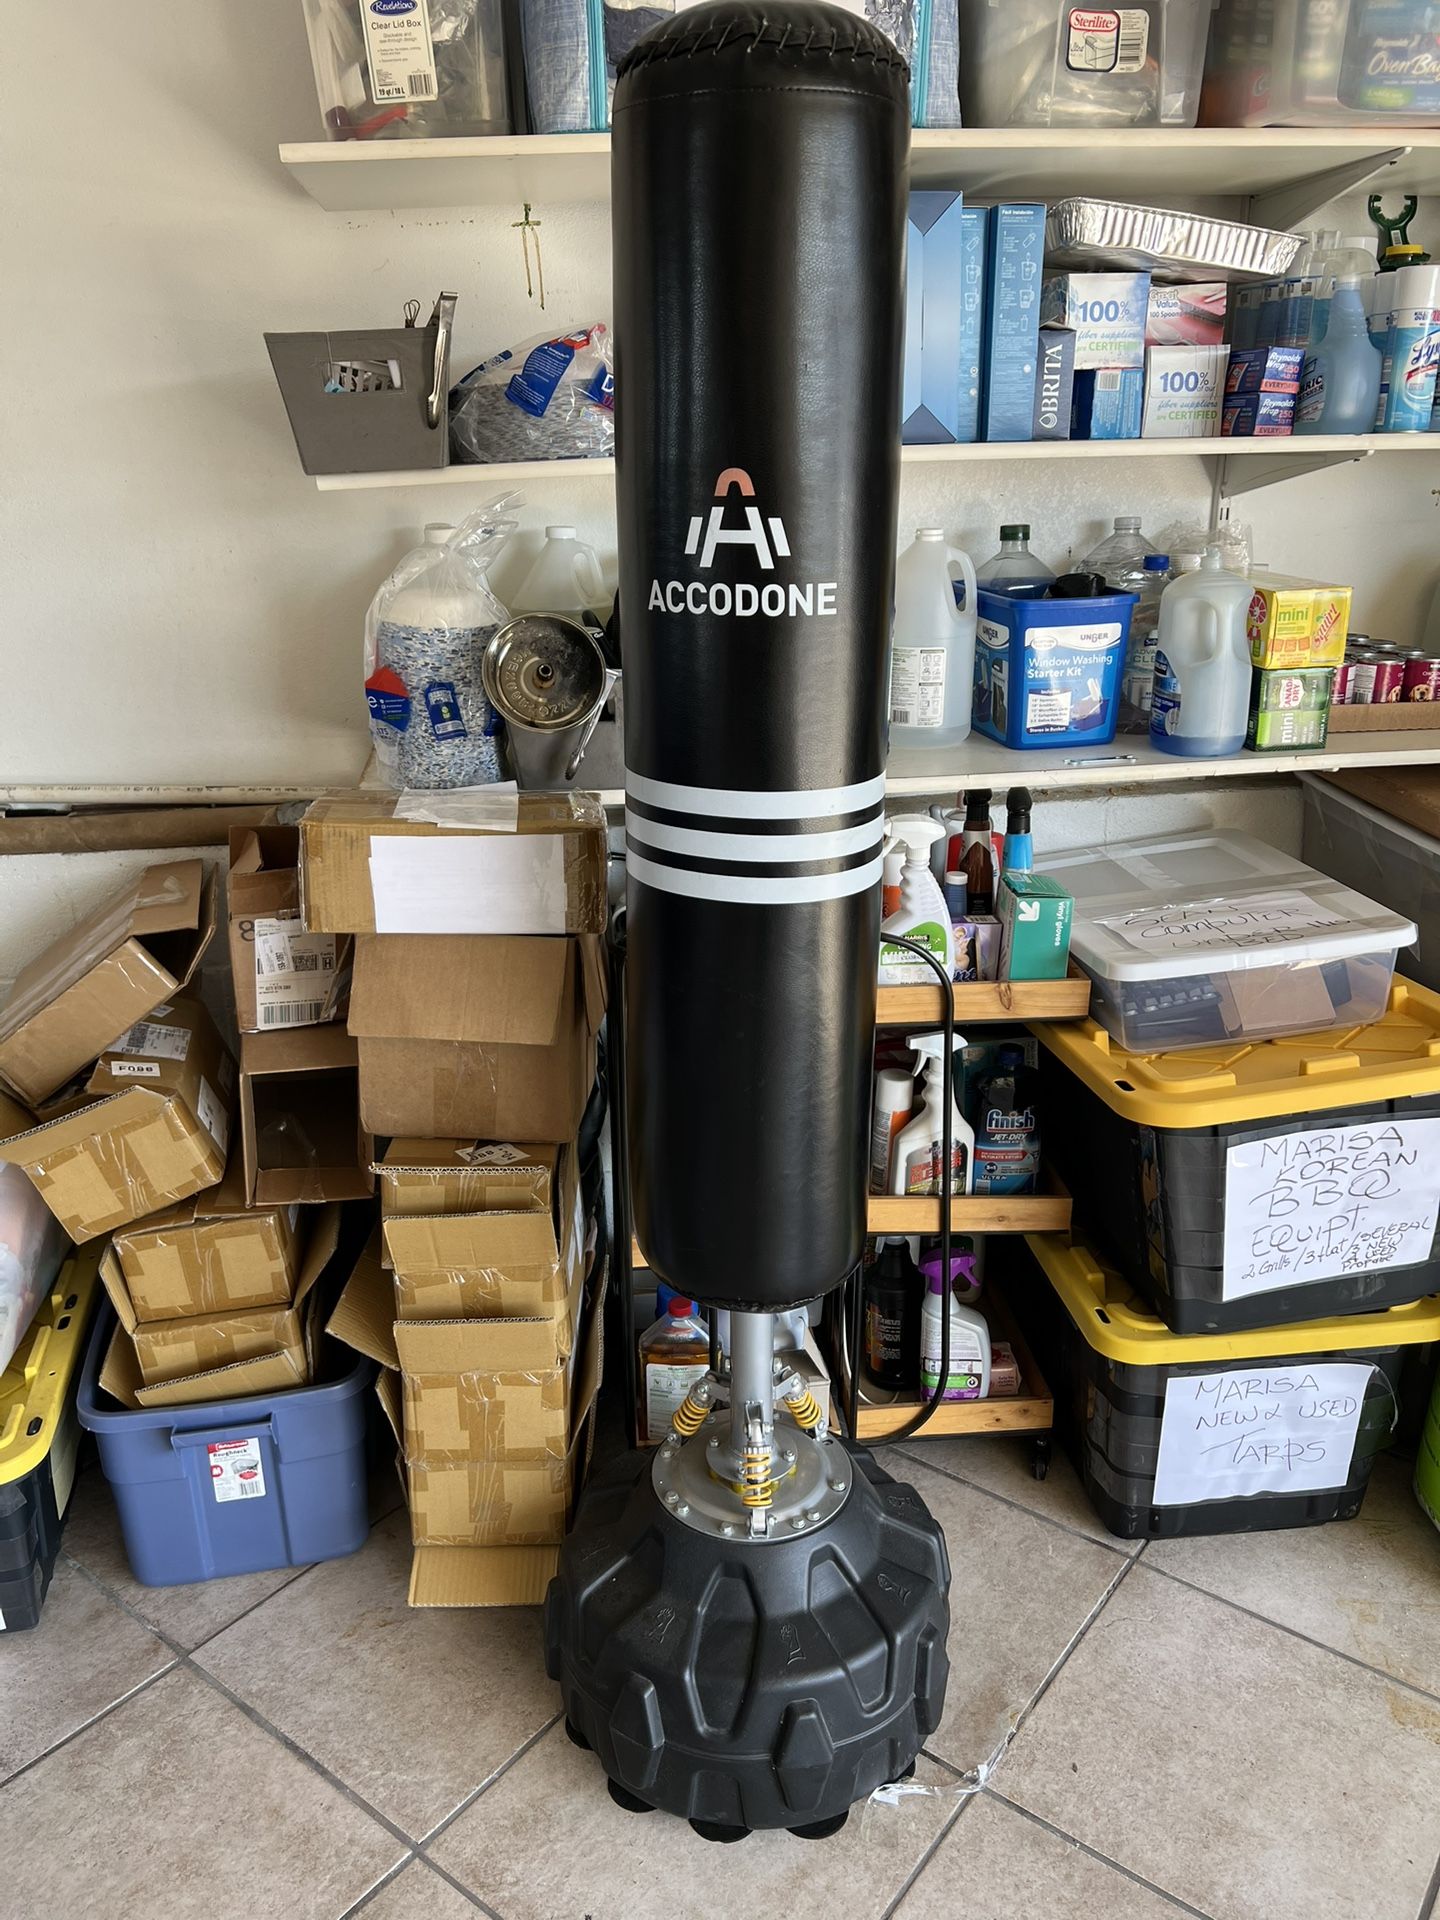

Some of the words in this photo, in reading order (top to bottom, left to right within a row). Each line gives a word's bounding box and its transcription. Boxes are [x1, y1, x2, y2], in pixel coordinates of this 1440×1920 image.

[371, 22, 391, 30] Clear
[393, 21, 405, 29] Lid
[1074, 14, 1113, 28] Sterilite
[1368, 51, 1409, 75] Oven
[1149, 289, 1180, 300] Great
[1079, 300, 1130, 322] 100%
[1156, 300, 1179, 308] Value
[1266, 360, 1286, 370] Wrap
[1269, 352, 1302, 363] Reynolds
[1041, 344, 1063, 412] BRITA
[1160, 371, 1209, 392] 100%
[1157, 400, 1178, 411] fiber
[1180, 400, 1218, 411] suppliers
[1260, 406, 1280, 416] Wrap
[1263, 399, 1296, 409] Reynolds
[1168, 410, 1217, 420] CERTIFIED
[648, 579, 838, 617] ACCODONE
[1279, 608, 1309, 621] mini
[982, 625, 999, 640] UNGER
[1080, 632, 1109, 643] UNGER
[1029, 657, 1071, 668] Window
[1073, 655, 1113, 665] Washing
[1027, 669, 1064, 678] Starter
[1067, 667, 1082, 677] Kit
[1292, 684, 1301, 701] DRY
[1281, 712, 1294, 743] mini
[1056, 901, 1066, 920] vinyl
[1054, 921, 1063, 946] gloves
[987, 1109, 1034, 1129] finish
[1261, 1127, 1404, 1168] MARISA
[1274, 1150, 1418, 1187] KOREAN
[1249, 1168, 1401, 1218] BBQ
[1195, 1375, 1319, 1408] MARISA
[1196, 1406, 1258, 1430] NEW
[1298, 1397, 1358, 1419] USED
[1200, 1428, 1326, 1471] TARPS
